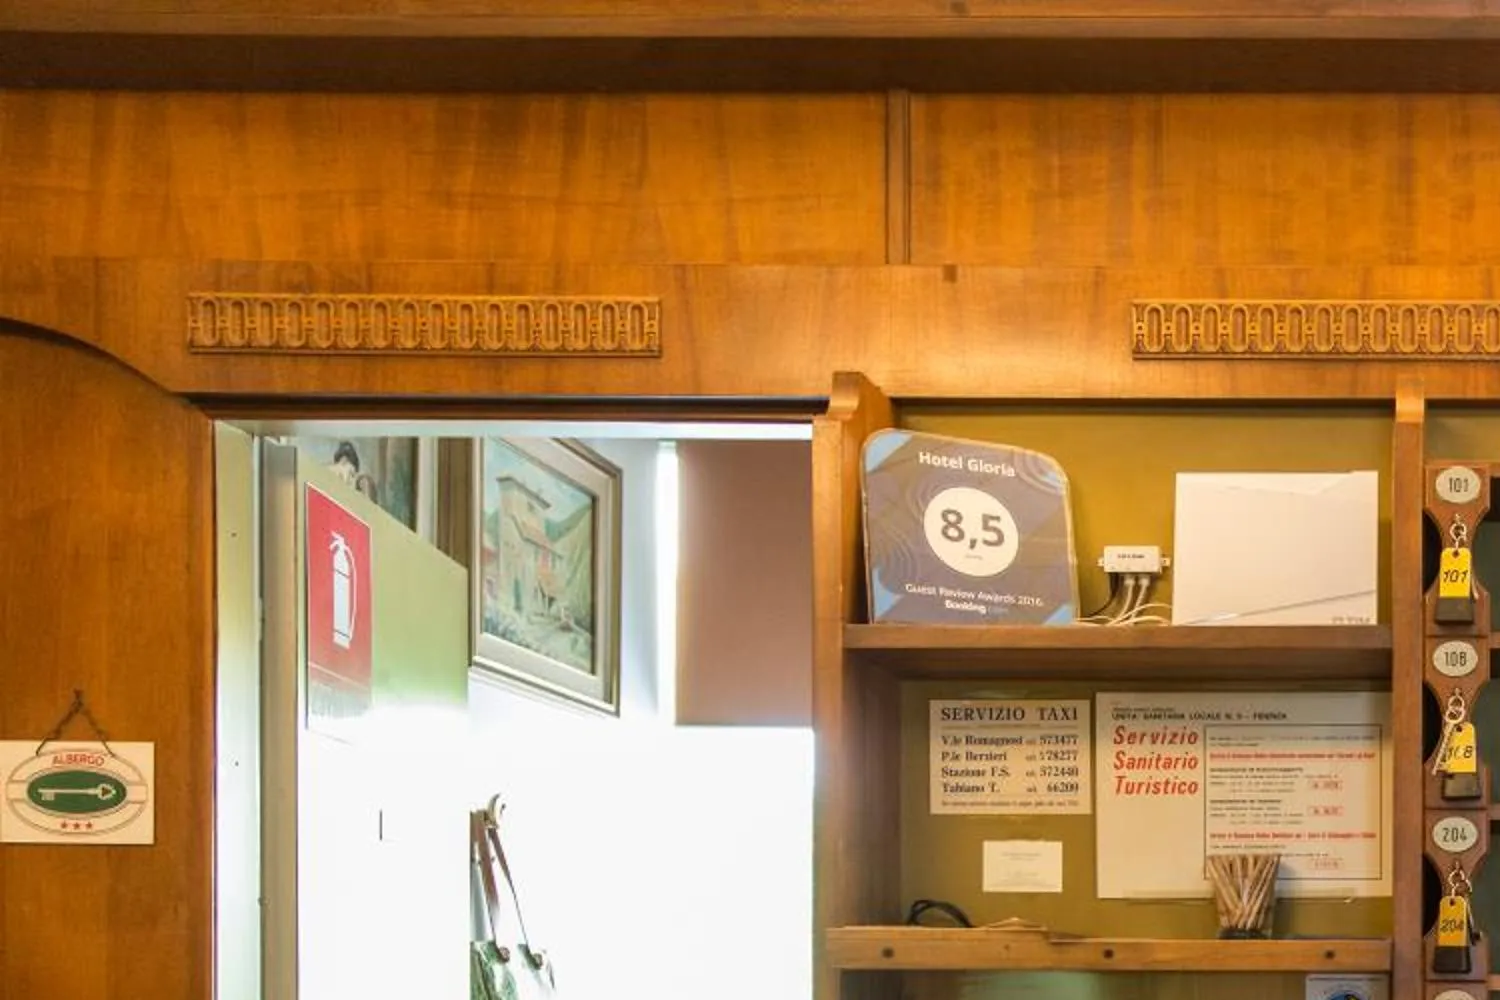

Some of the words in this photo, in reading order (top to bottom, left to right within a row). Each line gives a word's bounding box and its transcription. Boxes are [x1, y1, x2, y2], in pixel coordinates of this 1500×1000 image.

[919, 452, 963, 469] Hotel
[968, 459, 1016, 477] Gloria
[1449, 478, 1468, 492] 101
[940, 508, 1005, 550] 8,5
[1442, 569, 1469, 582] 101
[905, 584, 936, 596] Guest
[939, 587, 975, 600] Review
[978, 591, 1016, 604] Awards
[1445, 652, 1466, 666] 108
[941, 707, 1025, 721] SERVIZIO
[1039, 707, 1078, 721] TAXI
[1114, 726, 1199, 745] Servizio
[52, 753, 105, 767] ALBERGO
[1114, 750, 1199, 770] Sanitario
[1115, 775, 1199, 795] Turistico
[1443, 827, 1467, 842] 204
